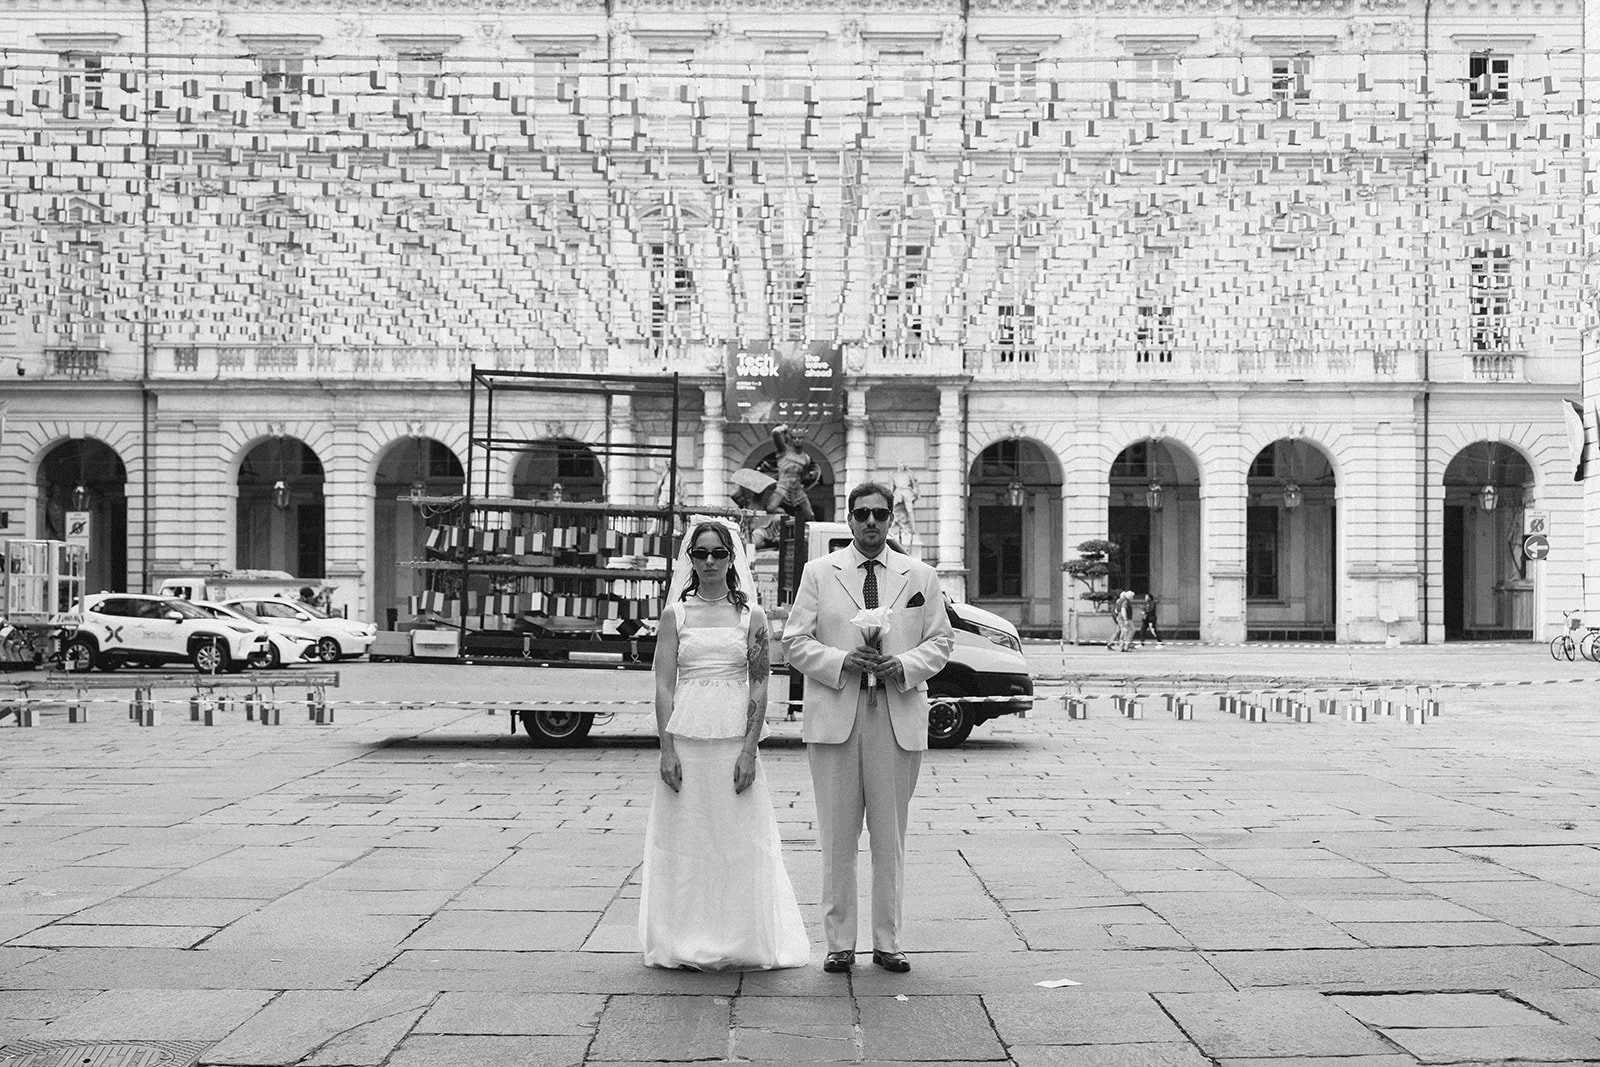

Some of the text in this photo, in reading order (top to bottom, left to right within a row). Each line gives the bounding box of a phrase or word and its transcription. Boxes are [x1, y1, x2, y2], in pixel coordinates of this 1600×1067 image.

[736, 353, 774, 366] Tech
[736, 365, 779, 377] week
[804, 369, 833, 377] ahead
